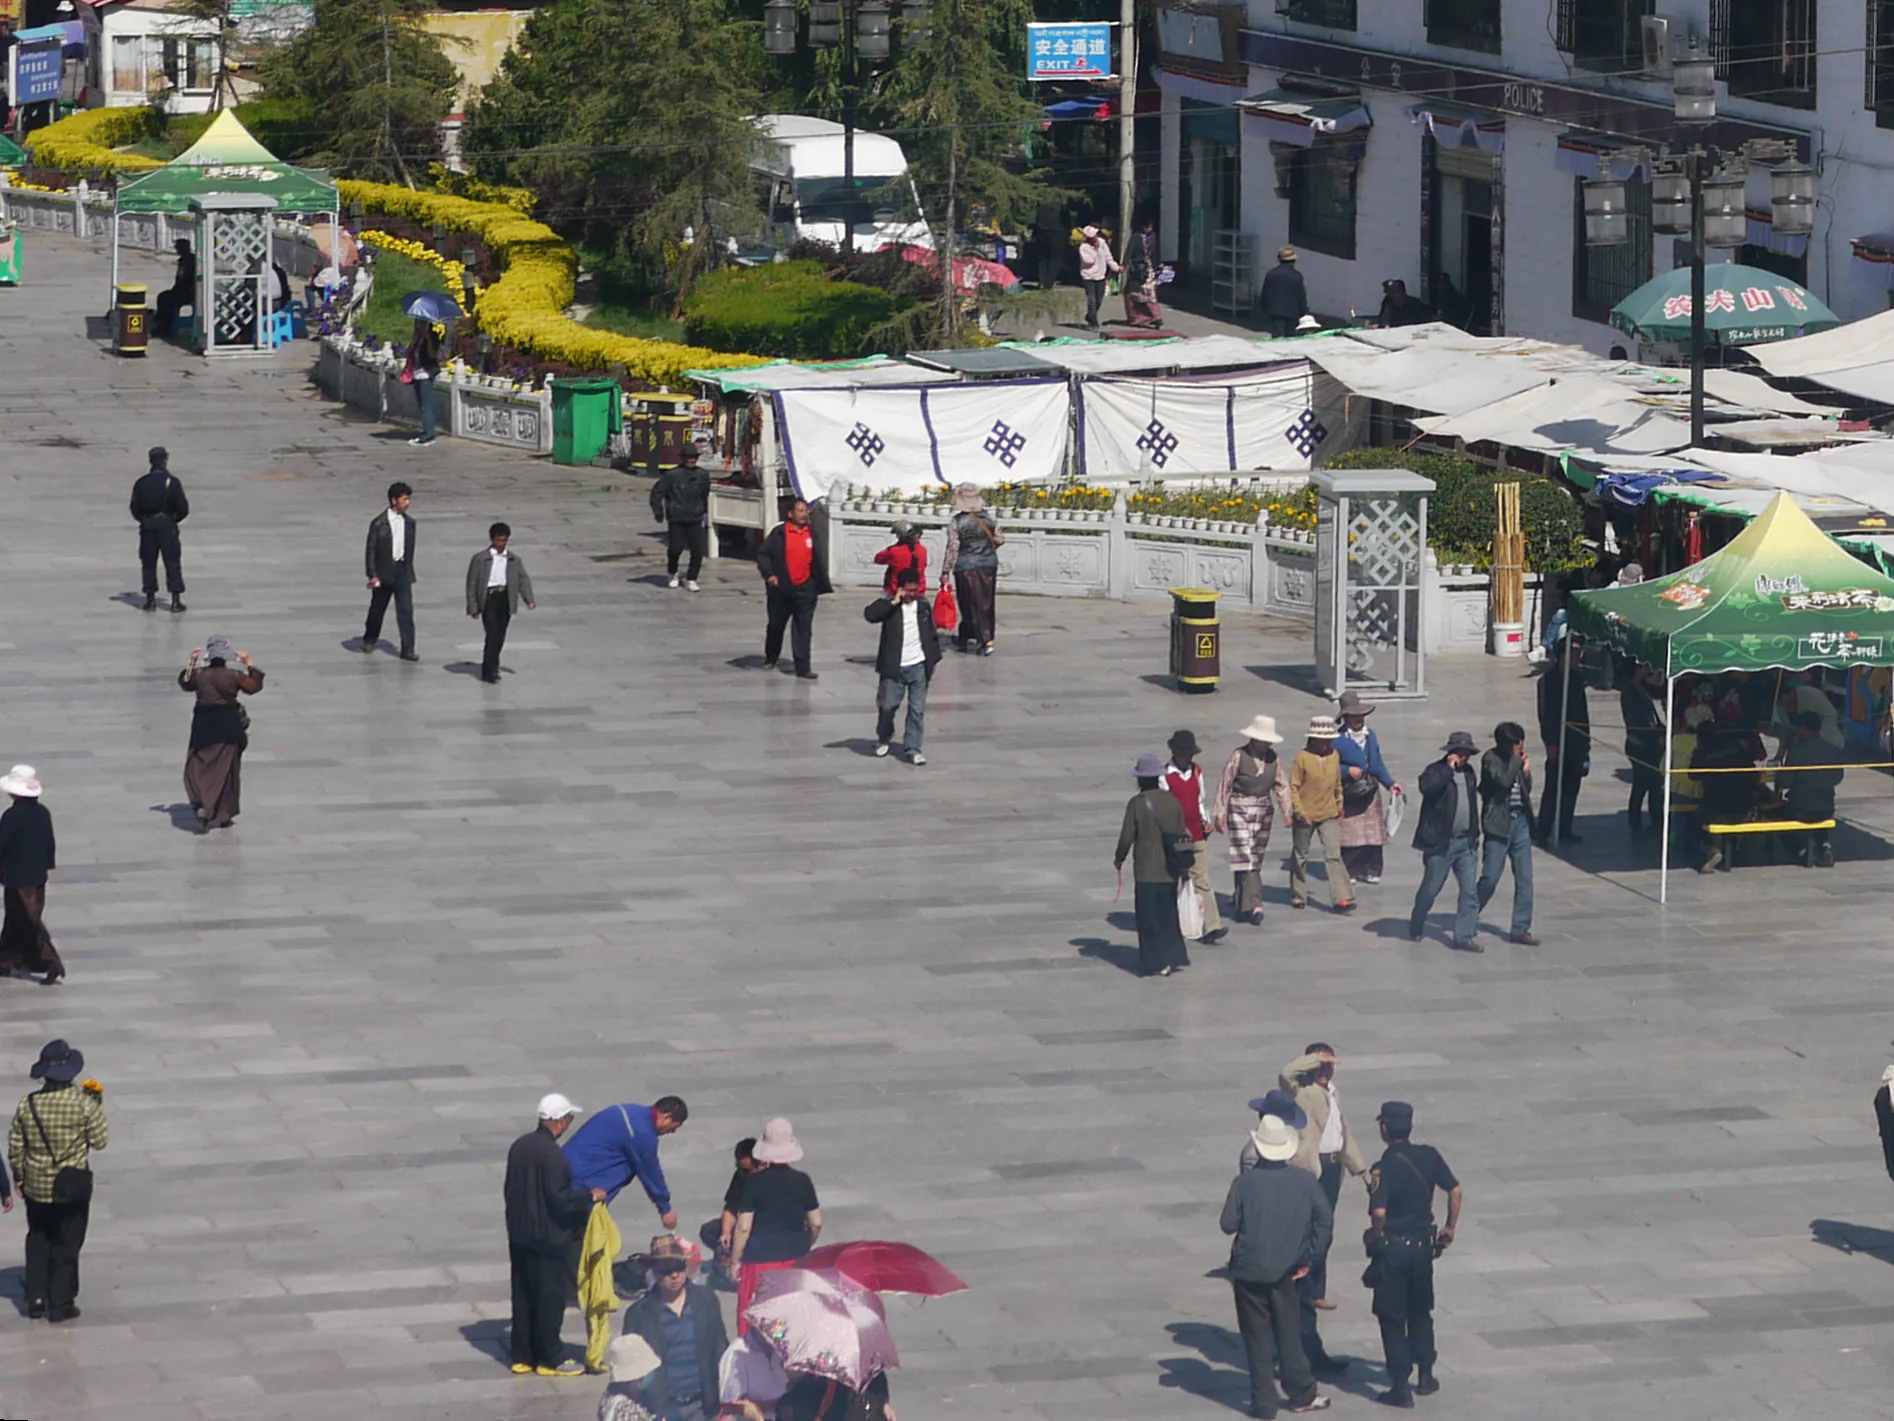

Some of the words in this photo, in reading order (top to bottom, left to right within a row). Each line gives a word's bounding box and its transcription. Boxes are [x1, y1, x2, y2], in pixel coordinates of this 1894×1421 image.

[1035, 39, 1105, 56] 安全通道
[1036, 60, 1070, 69] EXIT
[1504, 82, 1545, 114] POLICE
